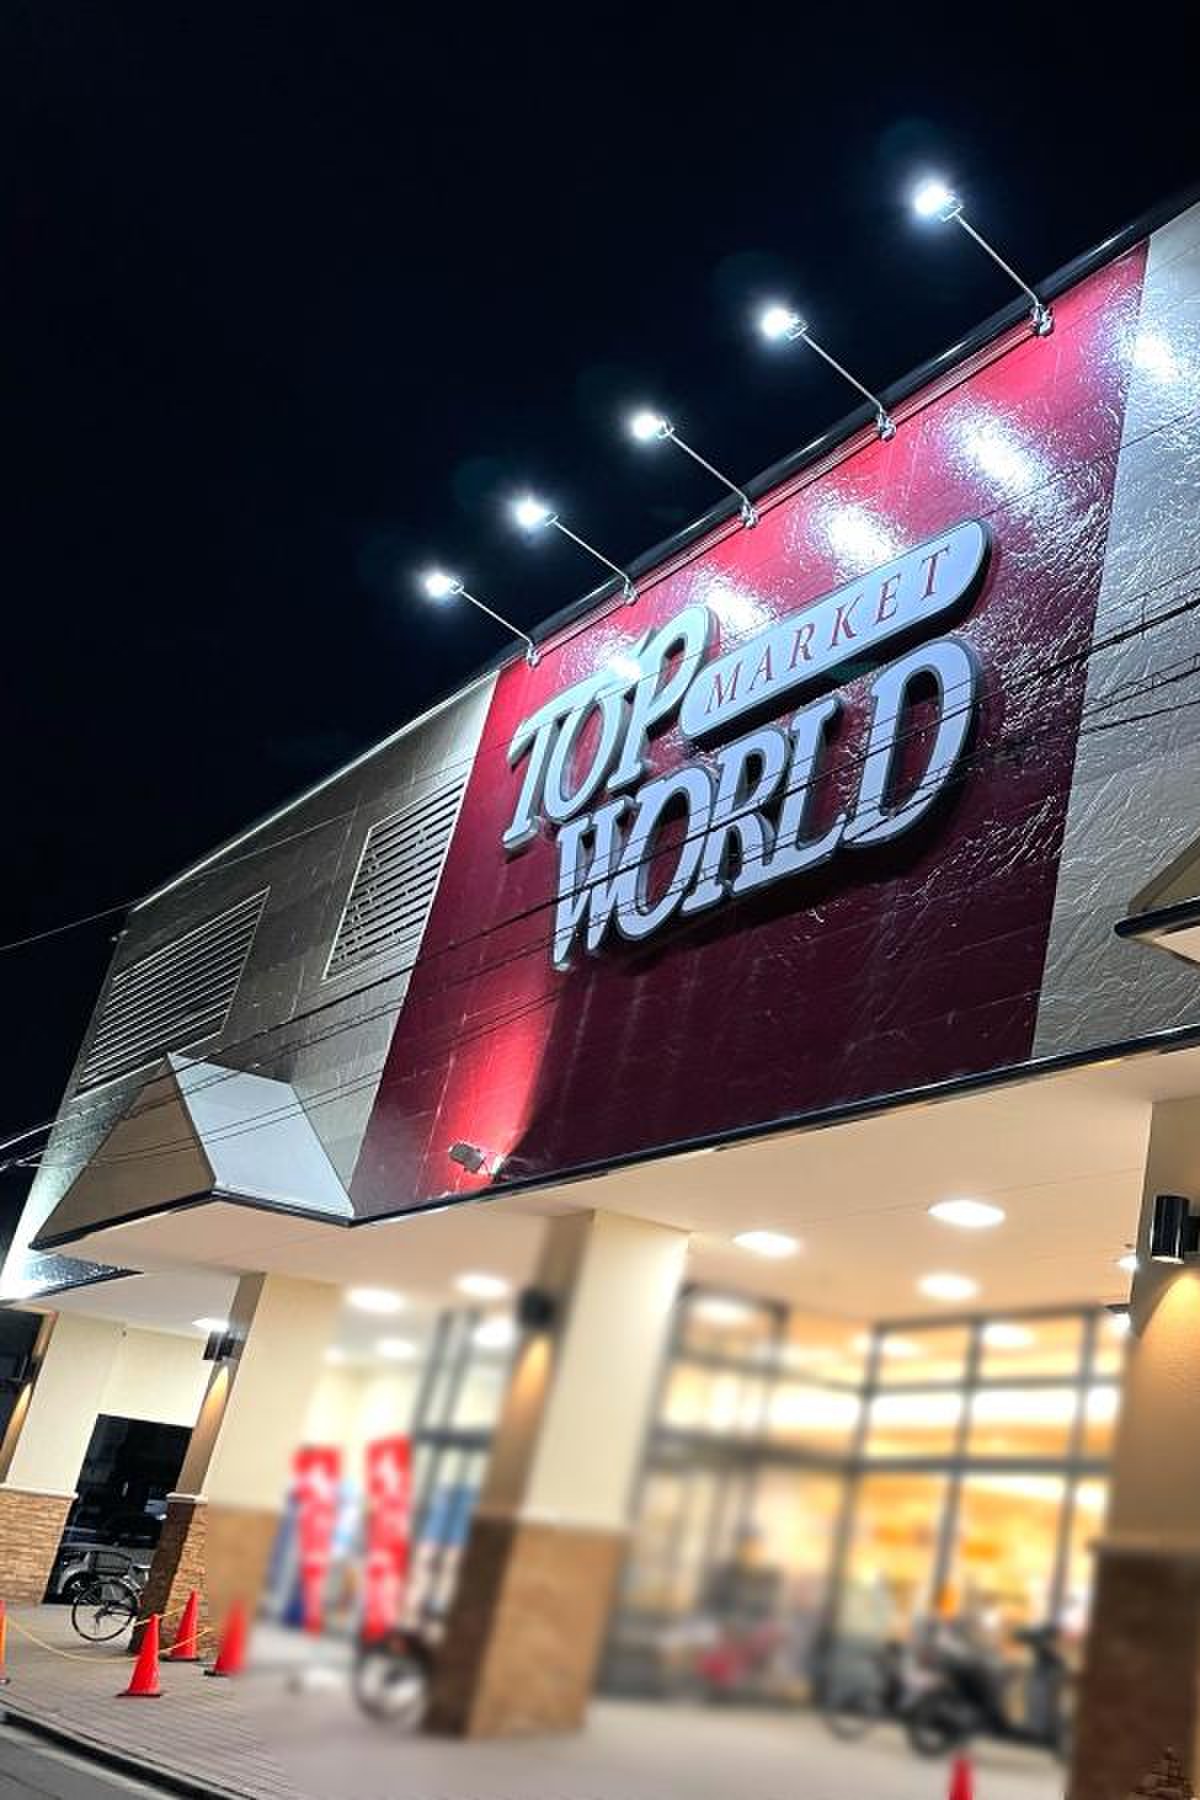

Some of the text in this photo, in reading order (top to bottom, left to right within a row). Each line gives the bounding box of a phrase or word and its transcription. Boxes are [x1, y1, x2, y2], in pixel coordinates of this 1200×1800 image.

[502, 604, 715, 850] TOP
[703, 546, 950, 715] MARKET
[551, 637, 979, 971] WORLD
